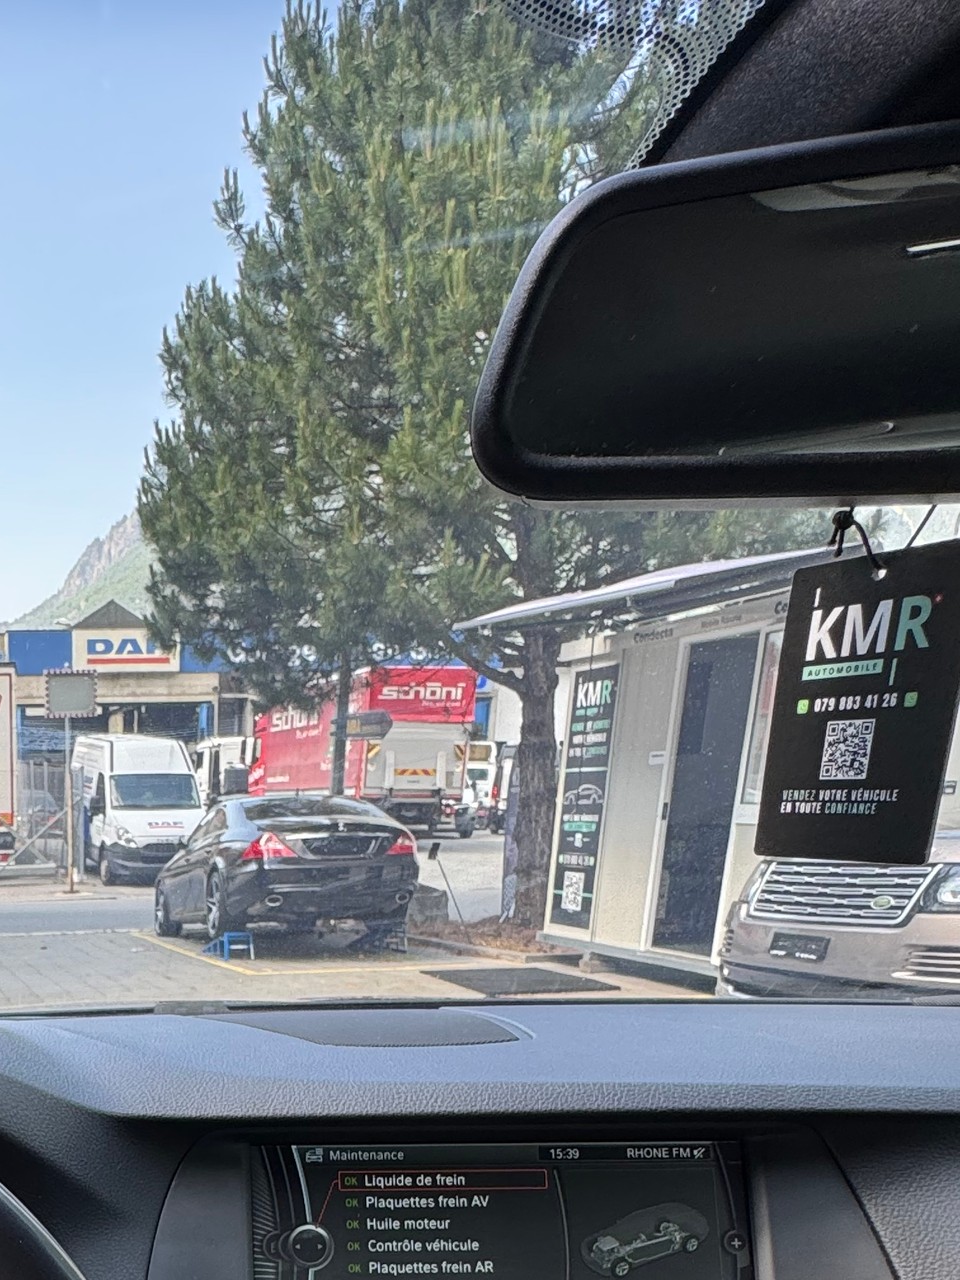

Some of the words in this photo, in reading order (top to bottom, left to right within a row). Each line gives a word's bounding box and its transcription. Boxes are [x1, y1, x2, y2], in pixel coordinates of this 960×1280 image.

[805, 595, 932, 662] KMR
[807, 662, 878, 678] AUTOMOBILE
[576, 680, 613, 709] KMR
[813, 698, 836, 713] 079
[864, 694, 879, 709] 41
[881, 692, 899, 708] 26
[782, 789, 816, 801] VENDEZ
[819, 789, 849, 801] VOTRE
[851, 787, 900, 801] VÉHICULE
[780, 802, 793, 814] EN
[795, 802, 822, 814] TOUTE
[824, 802, 878, 815] CONFIANCE
[329, 1150, 405, 1161] Maintenance
[549, 1148, 580, 1160] 15:39
[626, 1147, 670, 1159] RHONE
[672, 1147, 691, 1159] FM
[344, 1176, 358, 1187] OK
[364, 1174, 413, 1189] Liquide
[416, 1174, 432, 1187] de
[435, 1173, 466, 1186] frein
[345, 1198, 359, 1208] OK
[365, 1195, 435, 1210] Plaquettes
[438, 1195, 468, 1208] frein
[471, 1195, 490, 1207] AV
[346, 1219, 360, 1229] OK
[366, 1218, 401, 1230] Huile
[404, 1218, 451, 1230] moteur
[347, 1241, 361, 1251] OK
[368, 1239, 423, 1252] Contrôle
[425, 1239, 480, 1252] véhicule
[348, 1264, 362, 1274] OK
[368, 1261, 439, 1276] Plaquettes
[441, 1261, 472, 1274] frein
[474, 1261, 494, 1273] AR
